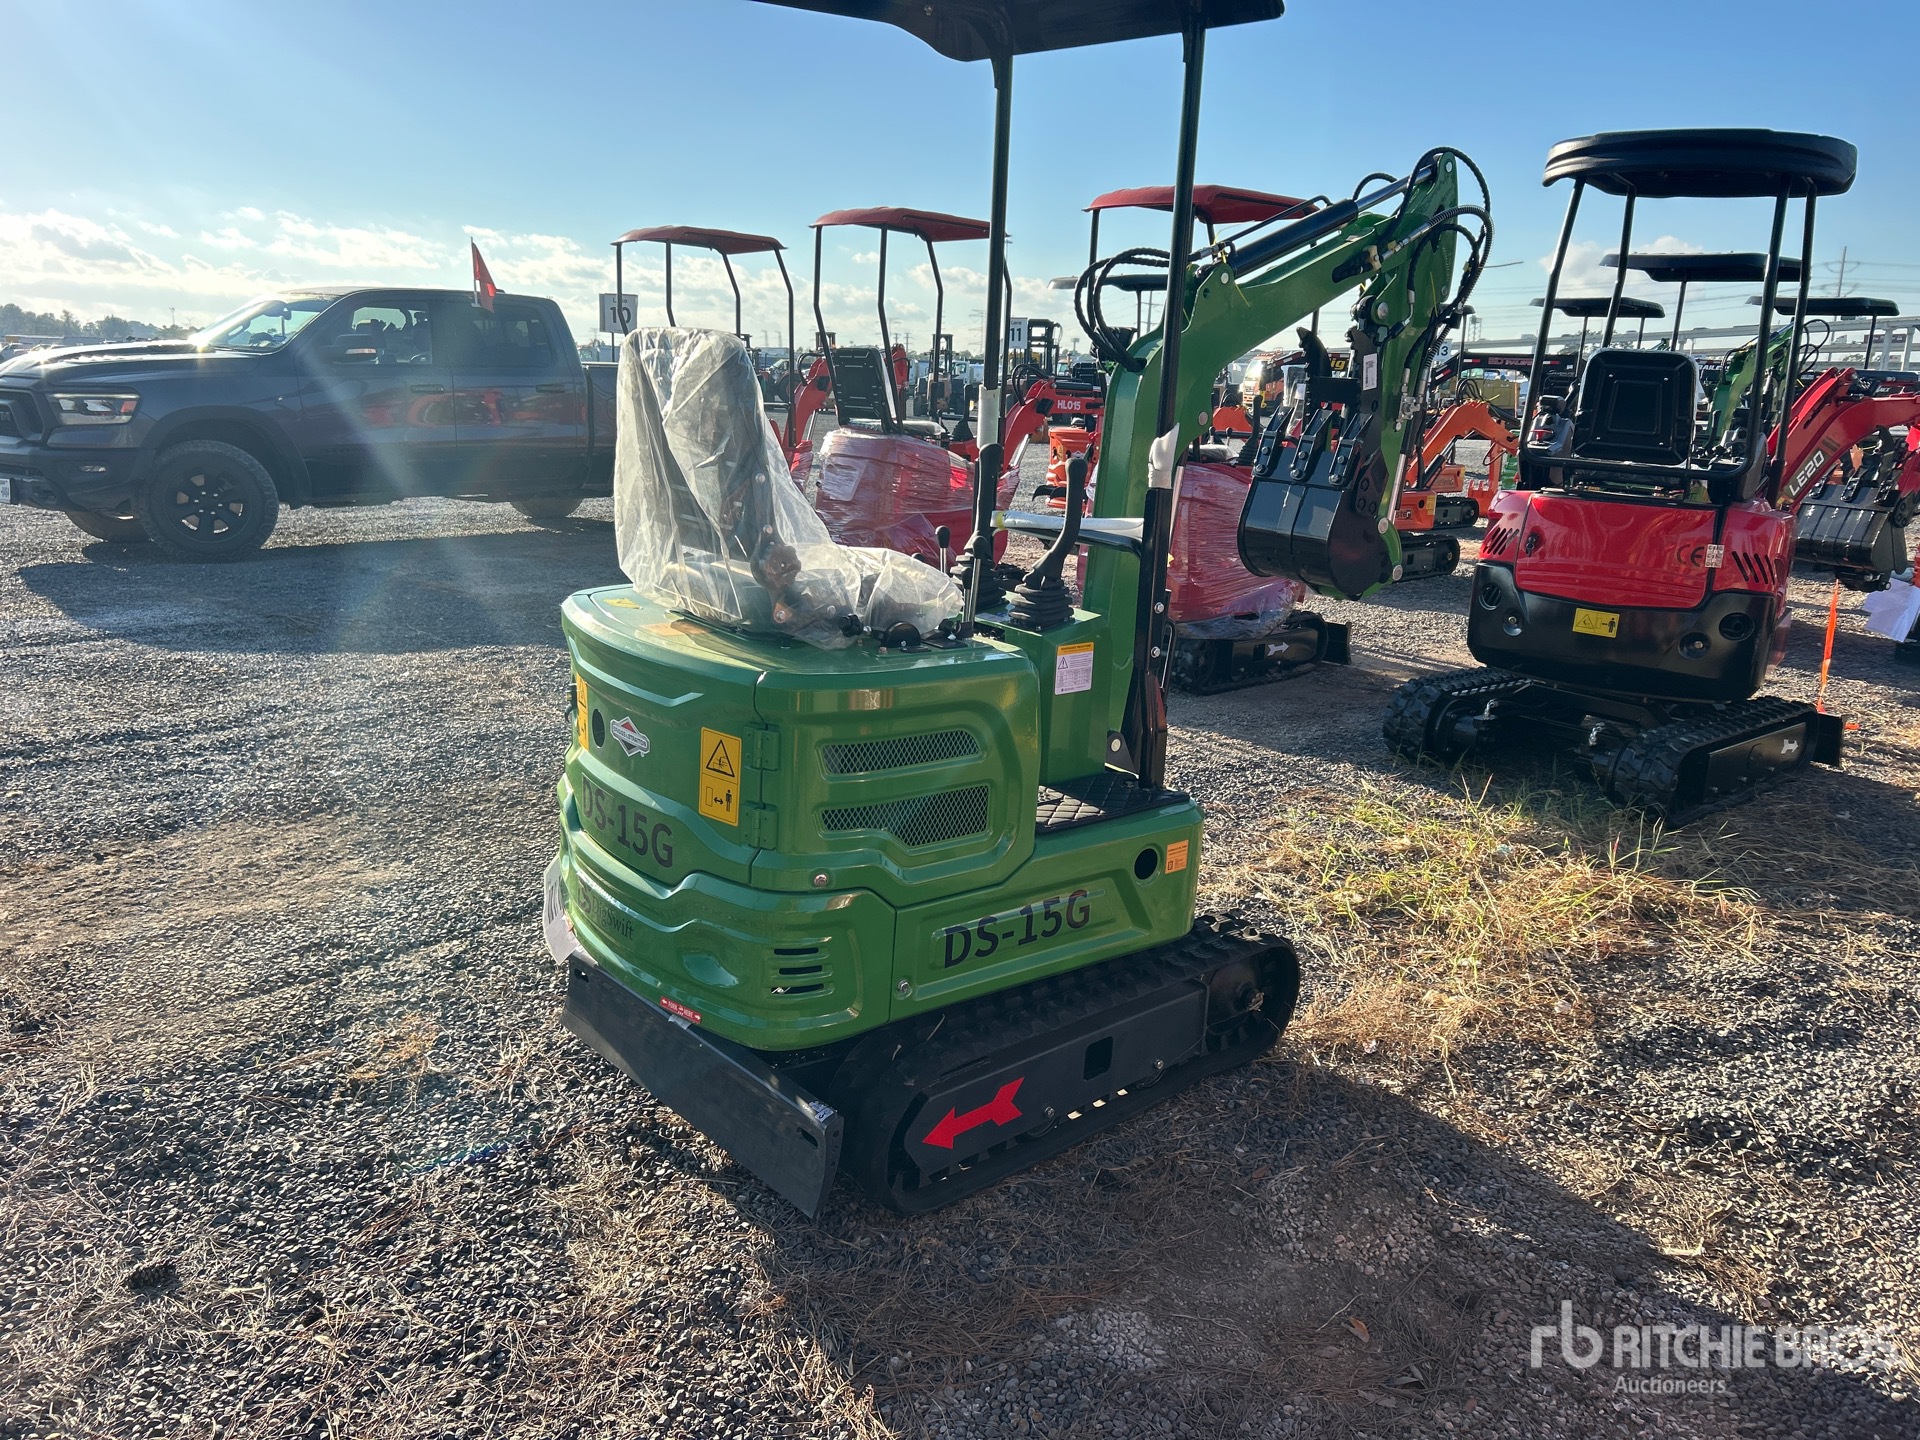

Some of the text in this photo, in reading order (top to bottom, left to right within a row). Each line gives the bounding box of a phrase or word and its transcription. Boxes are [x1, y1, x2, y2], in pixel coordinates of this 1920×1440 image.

[610, 306, 632, 324] 10
[1010, 327, 1022, 342] 11
[1789, 450, 1825, 497] LE20
[583, 776, 673, 868] DS-15G
[944, 889, 1091, 969] DS-15G
